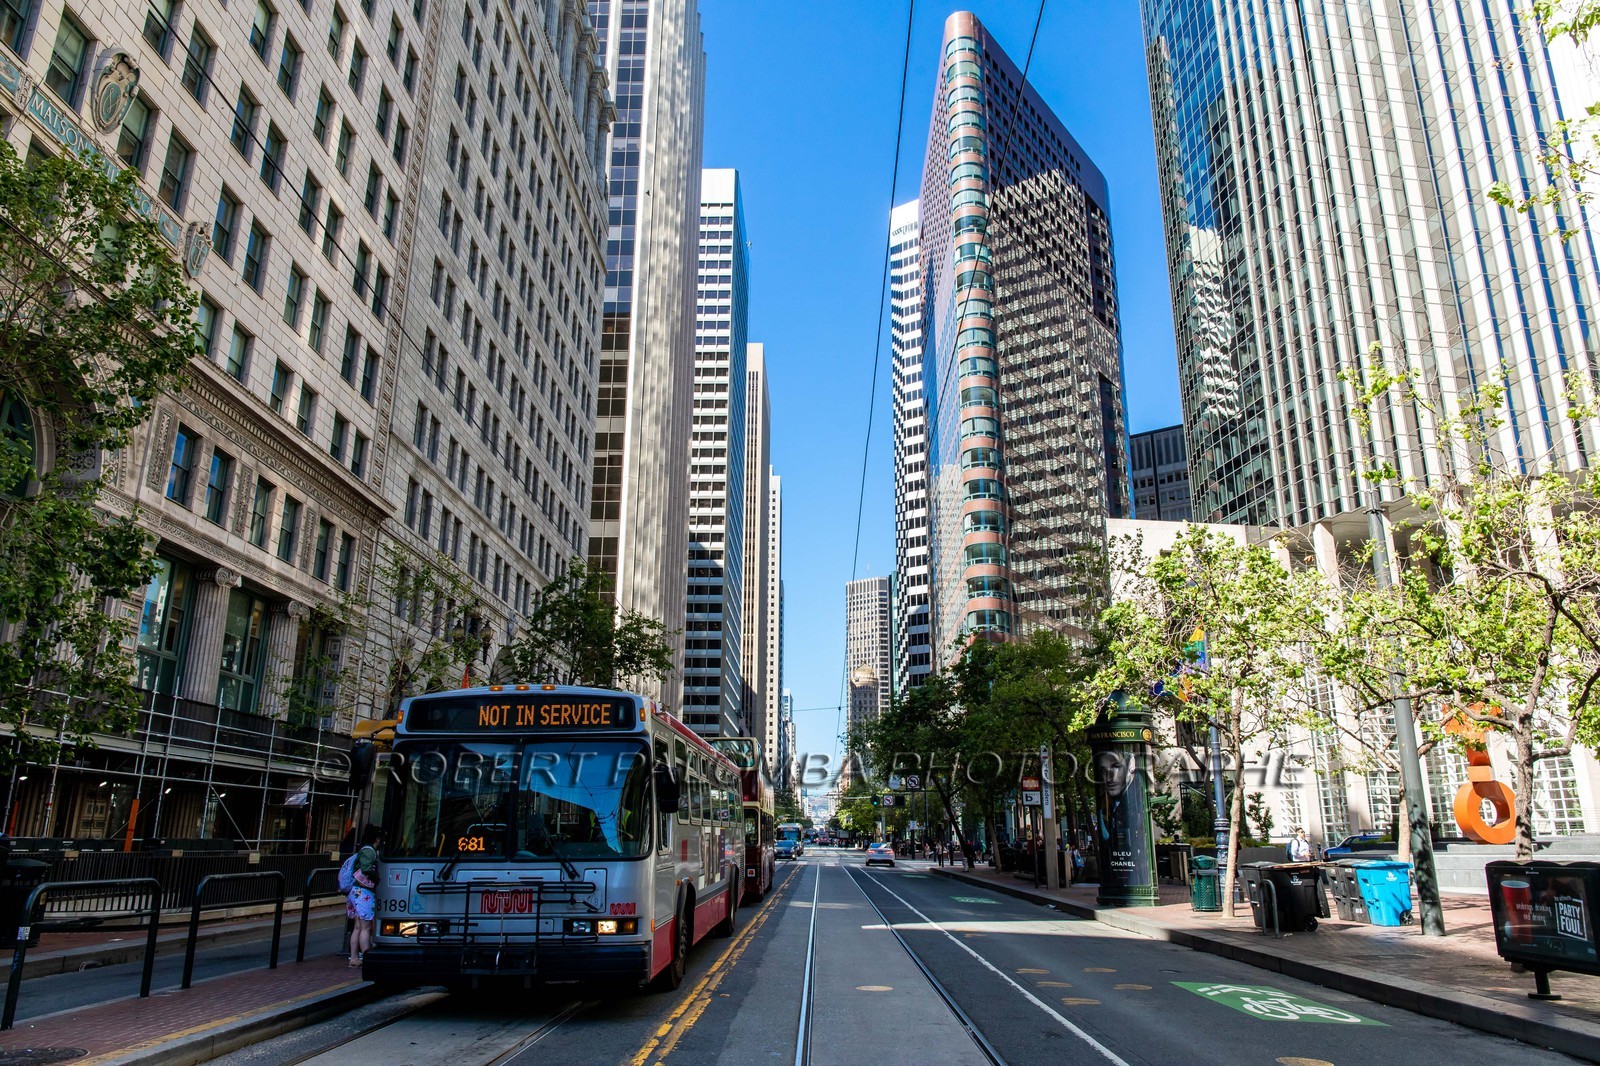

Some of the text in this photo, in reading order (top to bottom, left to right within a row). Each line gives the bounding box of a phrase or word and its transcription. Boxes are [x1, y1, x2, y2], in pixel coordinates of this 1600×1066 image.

[30, 93, 88, 152] MATSON
[478, 703, 612, 726] NOT IN SERVICE
[1101, 731, 1136, 739] FRANCISCO
[376, 898, 407, 913] 8189
[1559, 902, 1580, 919] PARTY
[1560, 916, 1583, 935] FOUL
